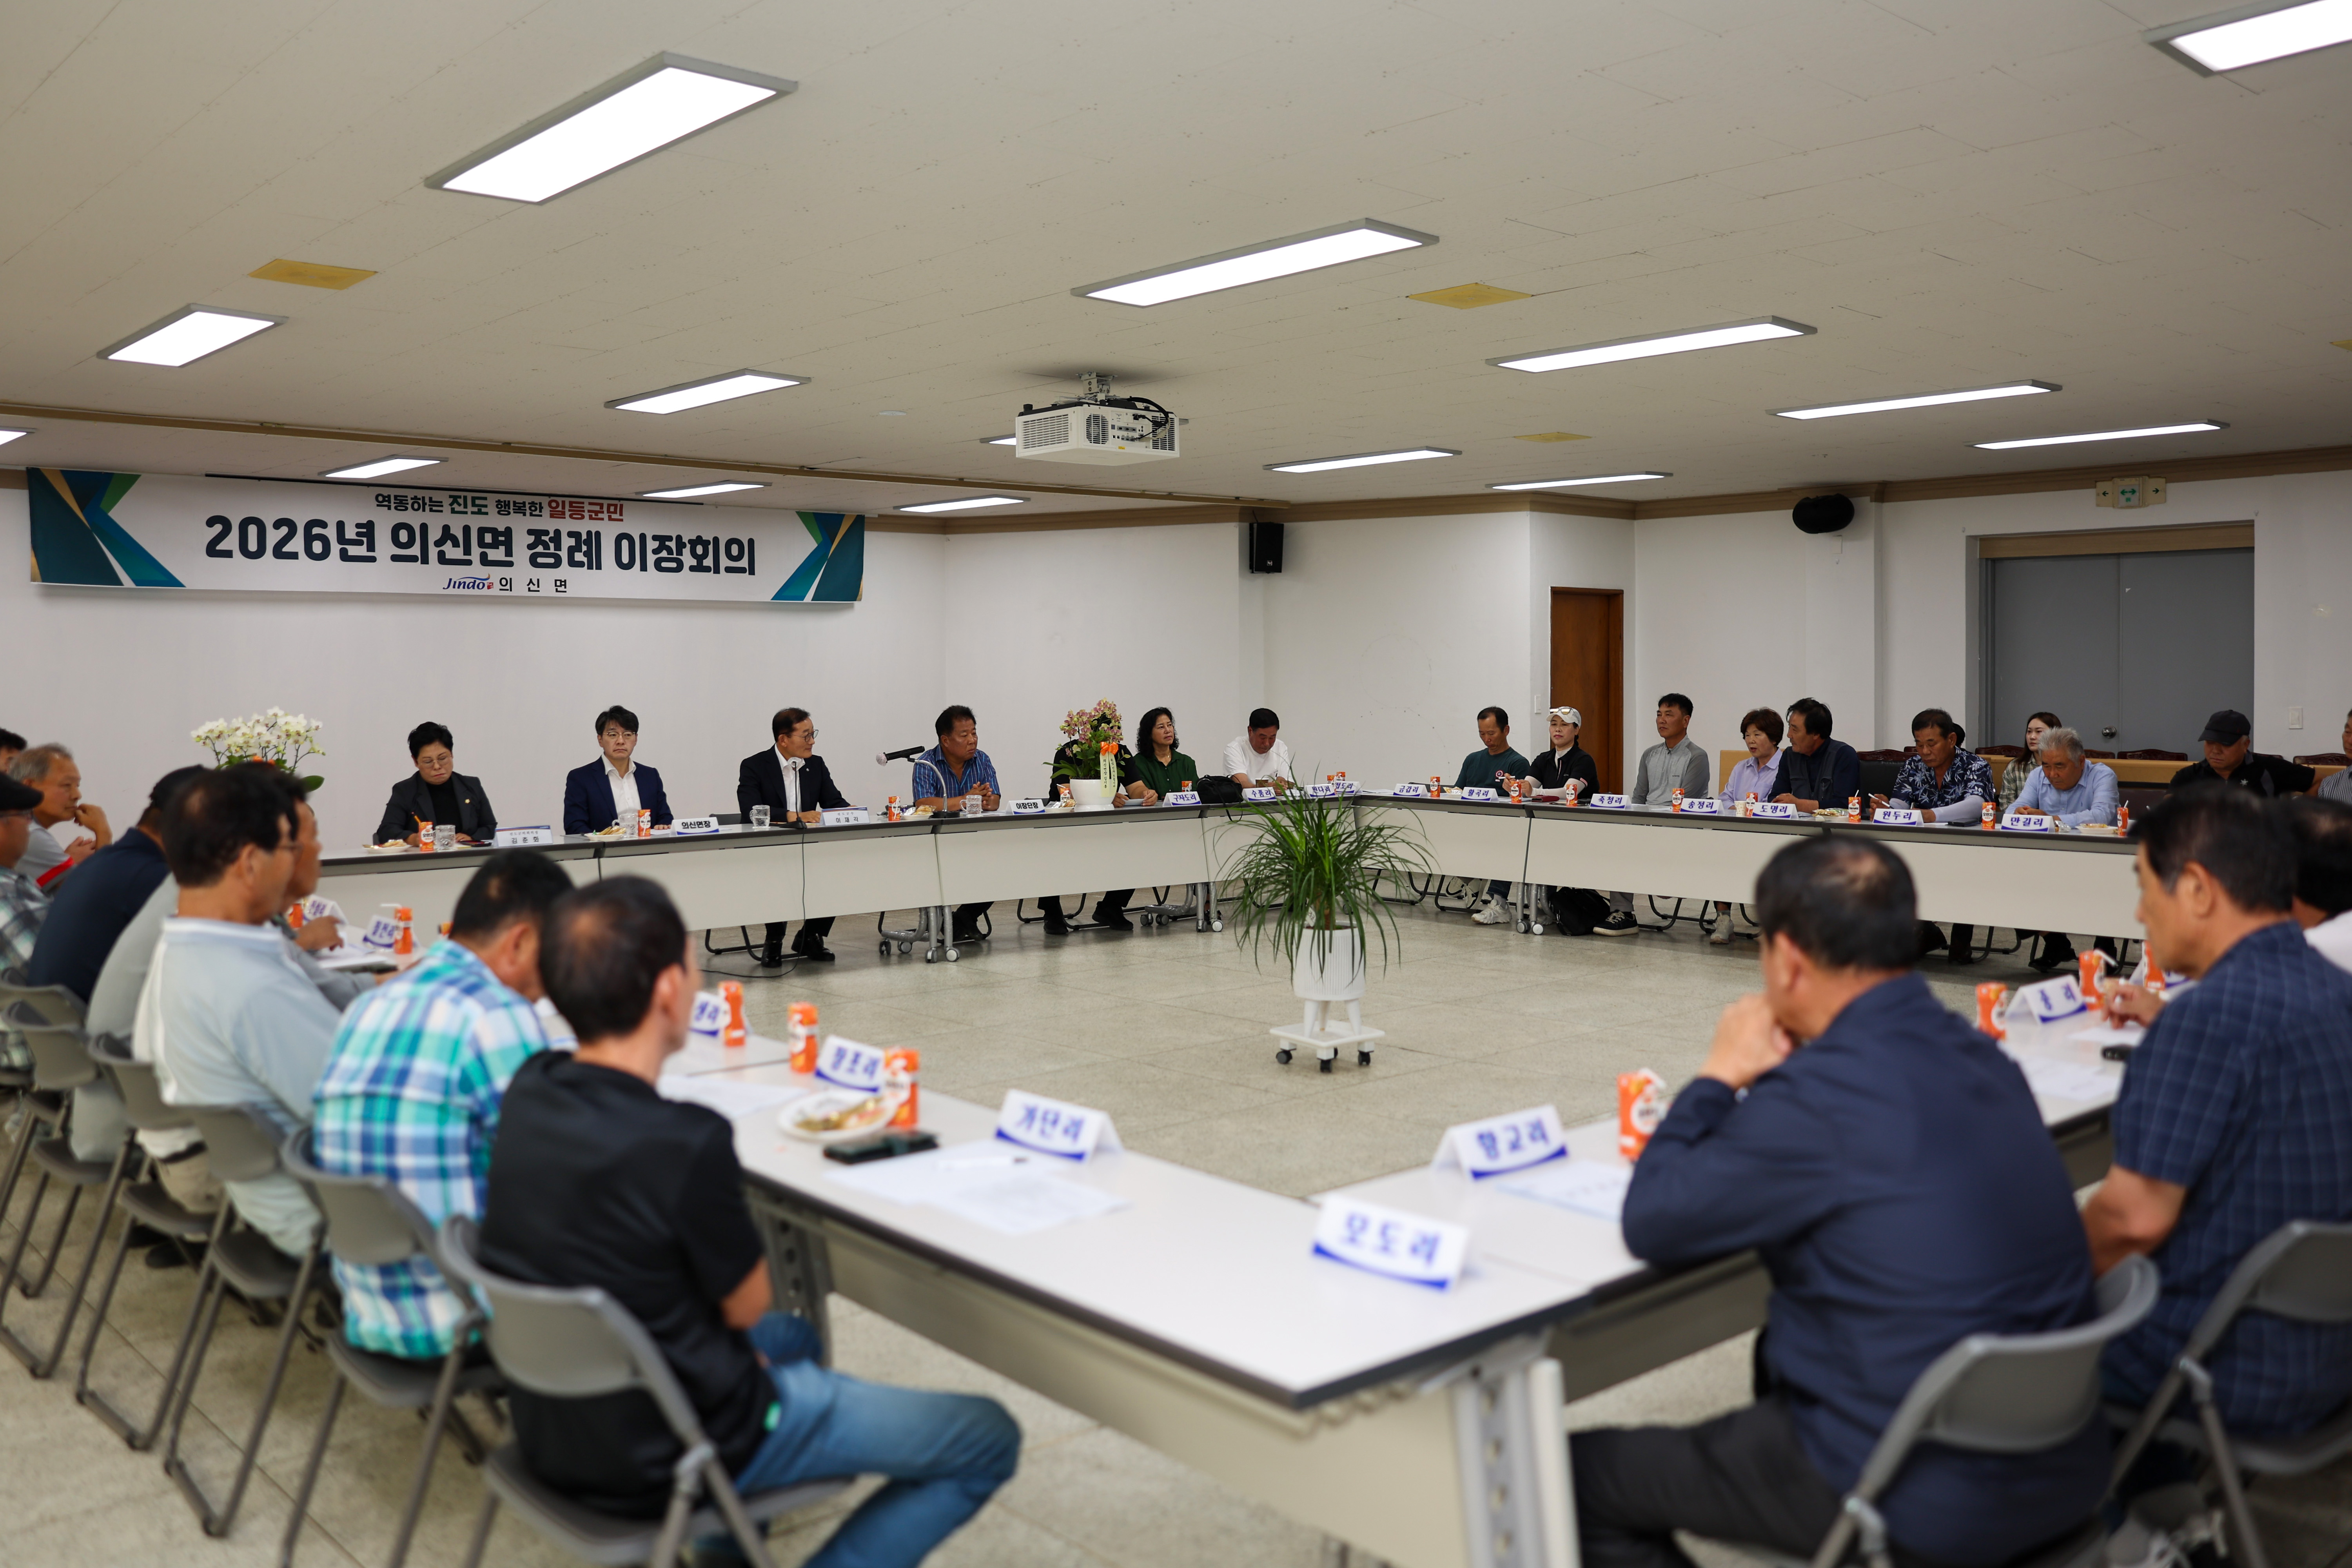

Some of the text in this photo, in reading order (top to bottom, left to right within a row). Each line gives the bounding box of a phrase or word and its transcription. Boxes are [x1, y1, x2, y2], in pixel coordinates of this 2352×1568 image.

[375, 493, 624, 522] 역동하는 진도 행복한 일등군민
[205, 515, 755, 575] 2026년 의신면 정례 이장회의
[443, 578, 486, 590] Jindo
[1173, 793, 1197, 802] 구자도리
[1252, 789, 1271, 797] 수품리
[1688, 801, 1714, 809] 송정리
[1760, 805, 1788, 814] 도명리
[1883, 811, 1912, 820] 원두리
[682, 821, 711, 829] 의신면장
[2011, 817, 2043, 827] 만길리
